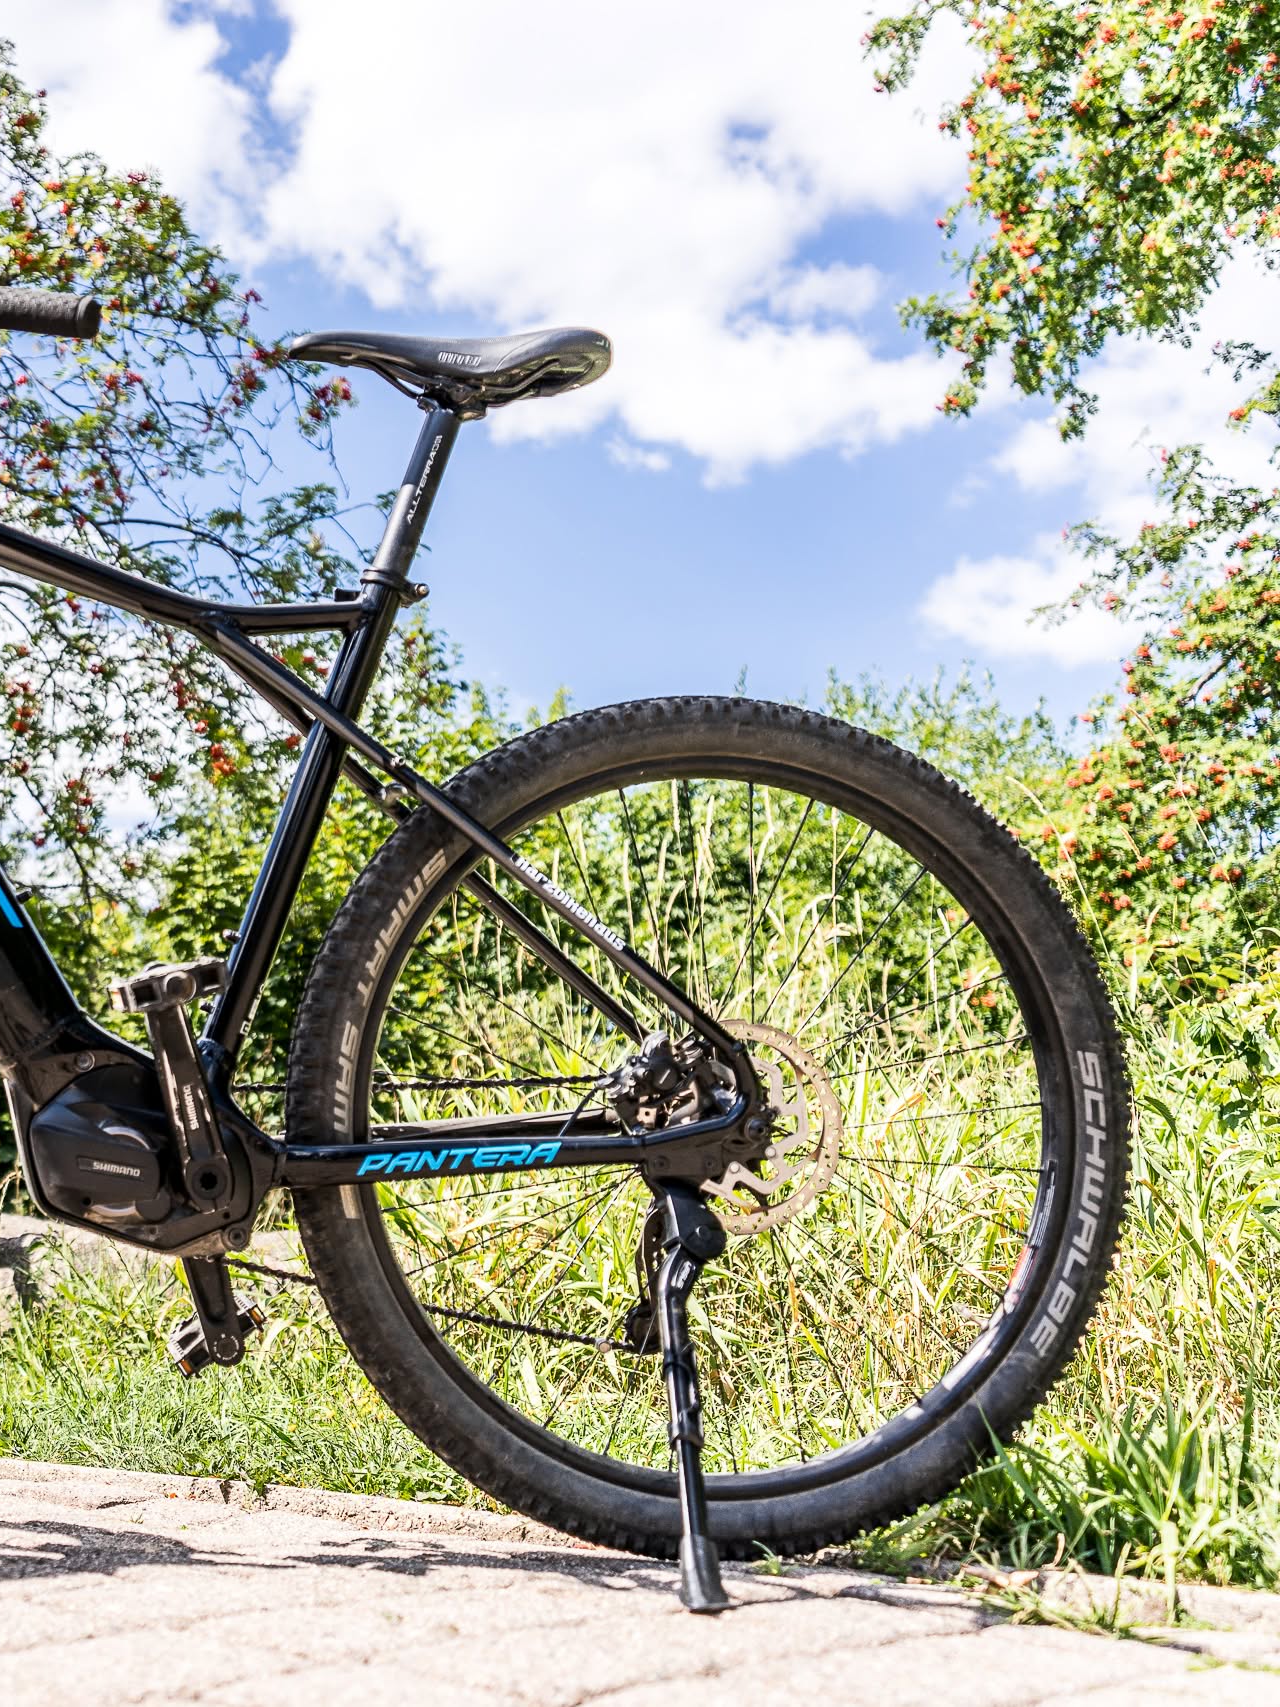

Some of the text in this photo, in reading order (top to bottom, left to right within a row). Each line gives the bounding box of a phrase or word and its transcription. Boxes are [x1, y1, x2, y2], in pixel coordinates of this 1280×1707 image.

[333, 848, 448, 1134] SMART SAM
[183, 1084, 201, 1131] SHIMANO
[92, 1161, 141, 1177] SHIMANO
[356, 1141, 563, 1177] PANTERA
[1029, 1050, 1107, 1358] SCHWALBE
